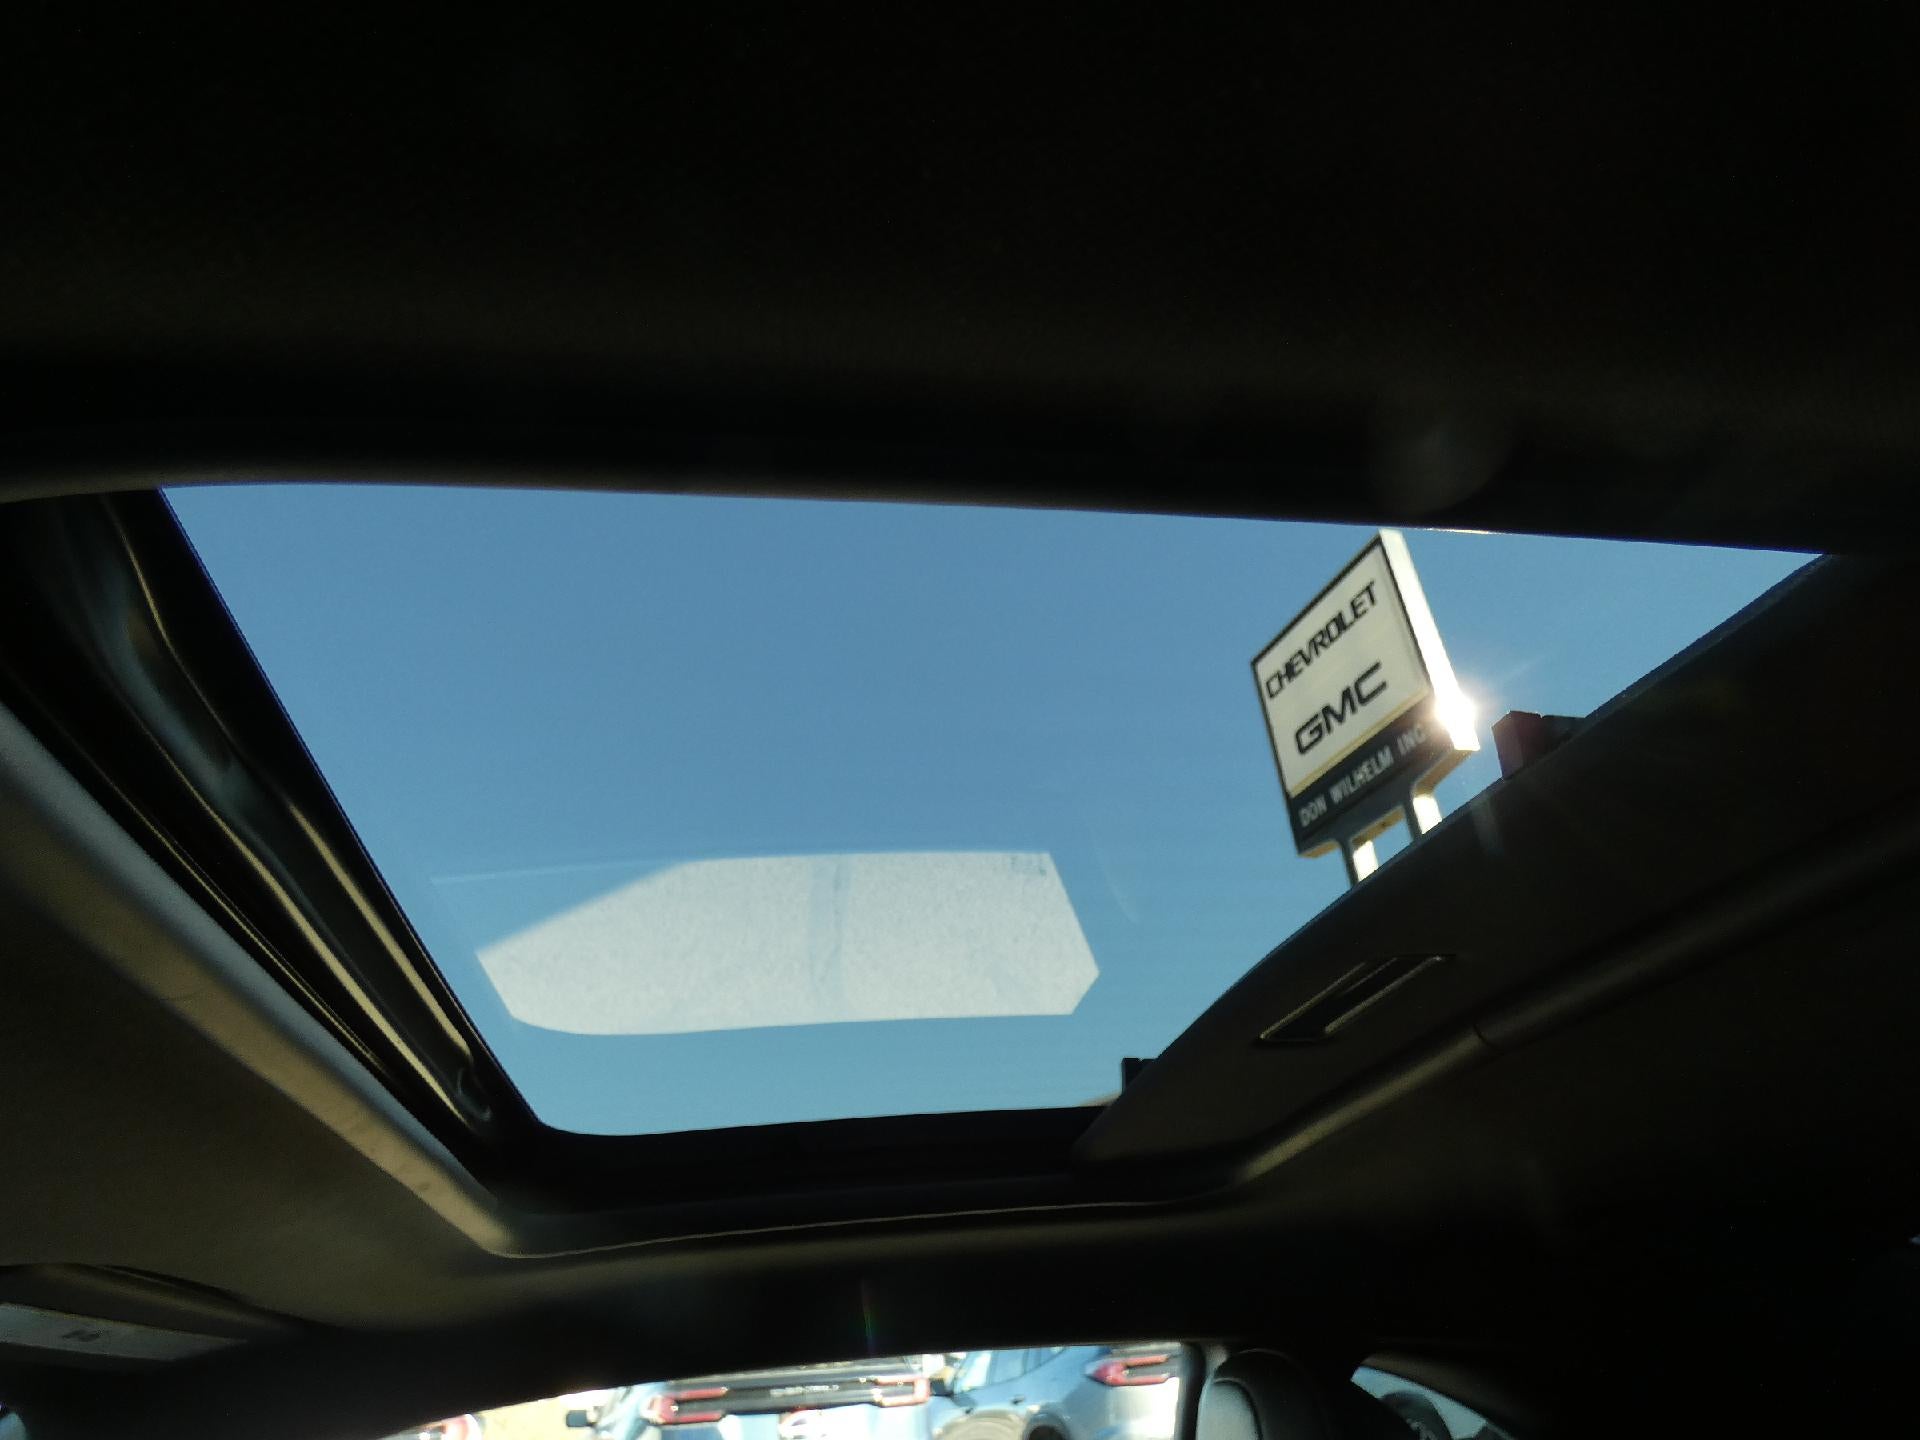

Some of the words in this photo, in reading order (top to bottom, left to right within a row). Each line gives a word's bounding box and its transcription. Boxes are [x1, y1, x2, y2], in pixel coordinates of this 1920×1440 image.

[1265, 580, 1377, 699] CHEVROLET
[1295, 661, 1388, 755] GMC
[1299, 794, 1327, 828] DON
[1329, 745, 1394, 804] WILHELM
